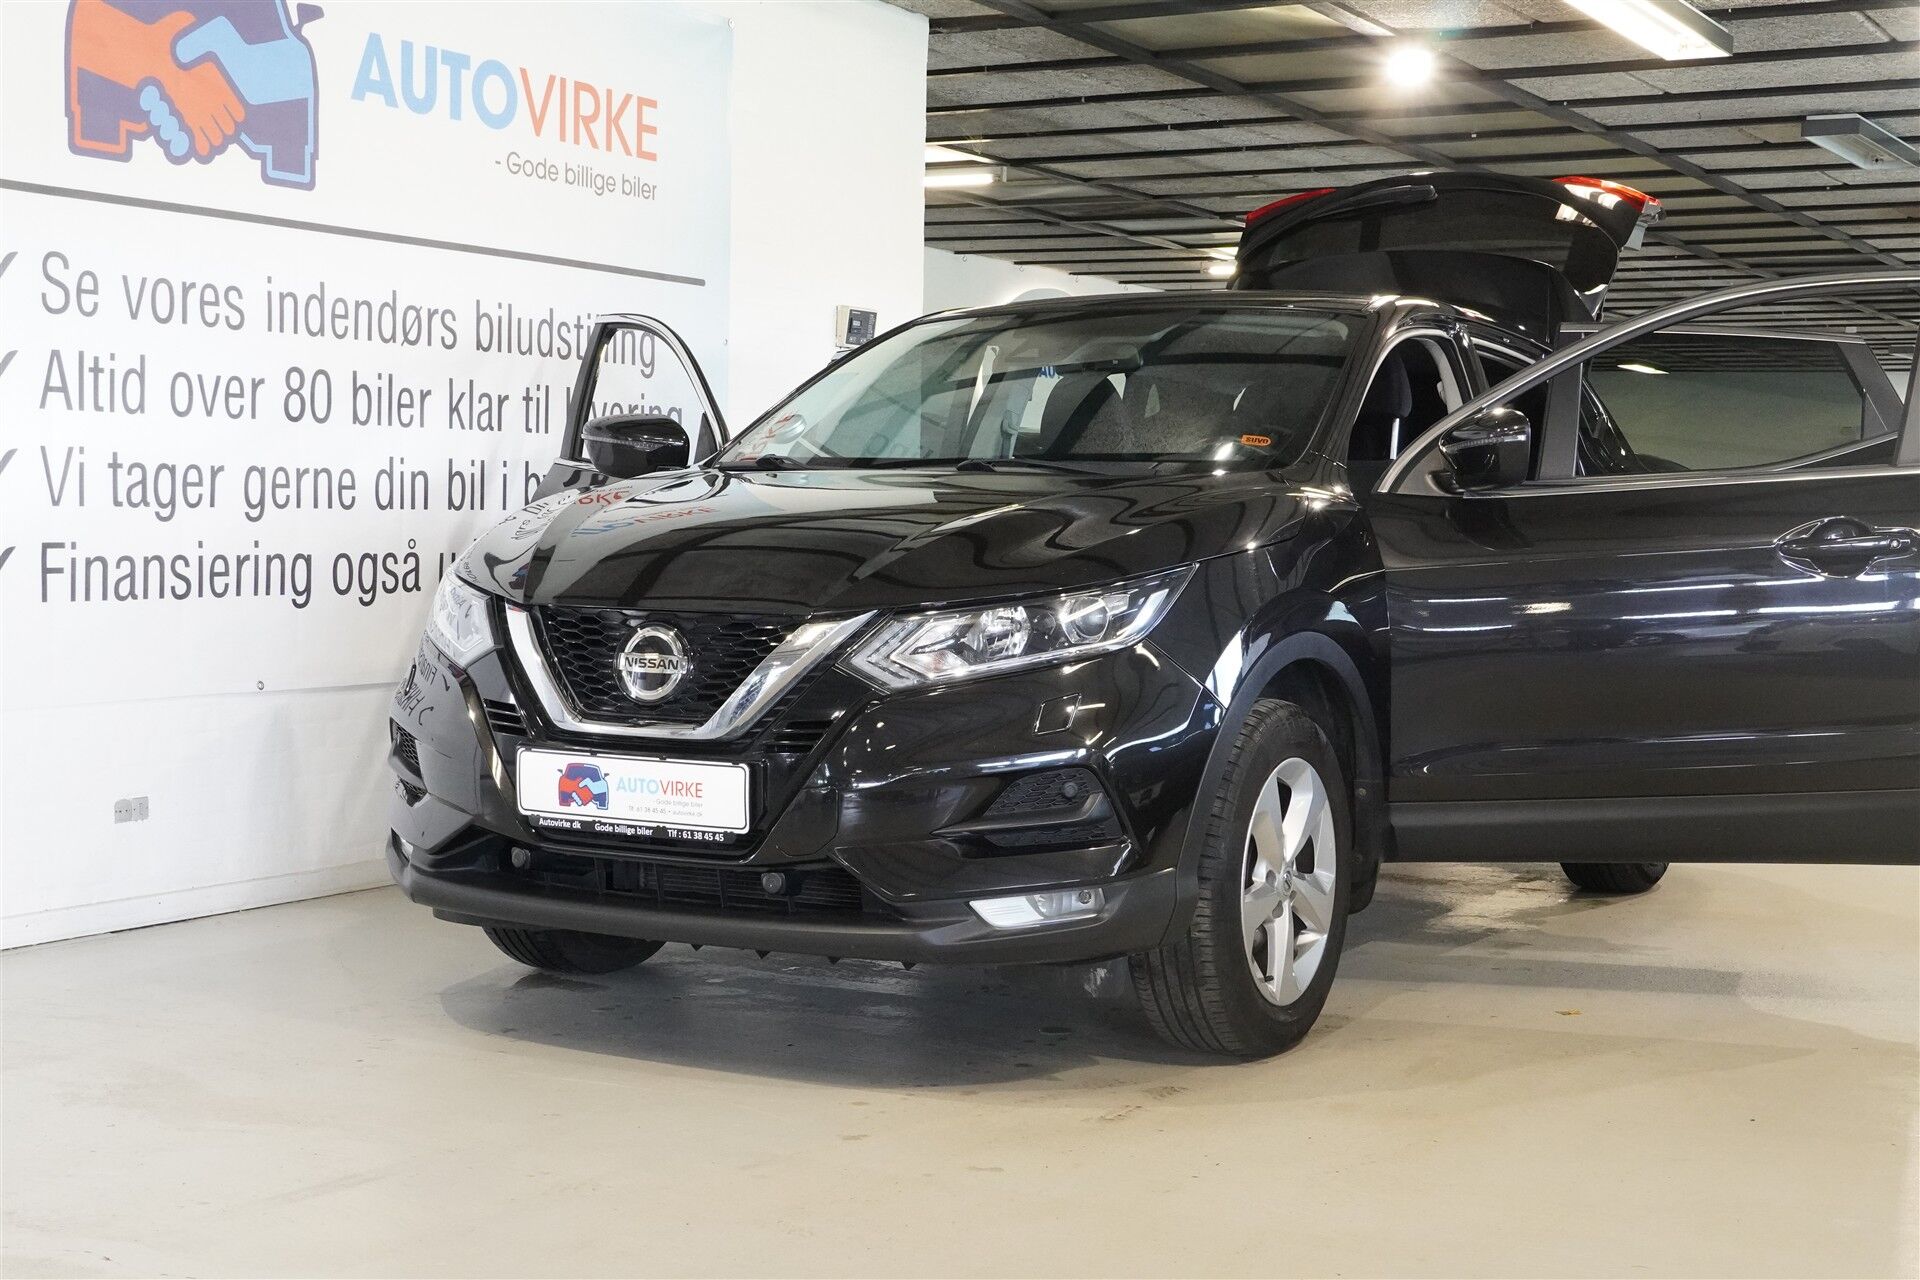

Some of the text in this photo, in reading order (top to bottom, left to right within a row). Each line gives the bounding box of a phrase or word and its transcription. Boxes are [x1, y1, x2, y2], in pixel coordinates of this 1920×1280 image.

[350, 31, 658, 163] AUTOVIRKE
[506, 151, 559, 182] Gode
[564, 162, 617, 196] billige
[621, 173, 658, 201] biler
[40, 250, 100, 318] Se
[122, 274, 246, 332] vores
[266, 275, 458, 351] indendørs
[38, 348, 146, 415] Altid
[169, 371, 266, 420] over
[283, 365, 333, 425] 80
[351, 368, 433, 429] biler
[448, 376, 511, 433] klar
[521, 383, 550, 435] til
[39, 444, 85, 508] Vi
[106, 451, 226, 523] tager
[243, 464, 357, 524] gerne
[374, 456, 430, 513] din
[447, 458, 485, 511] bil
[501, 459, 508, 511] i
[40, 538, 313, 611] Finansiering
[332, 537, 422, 609] også
[624, 656, 679, 671] NISSAN
[616, 777, 703, 799] AUTOVIRKE
[539, 817, 571, 828] Autovirke
[594, 823, 613, 833] Gode
[614, 824, 636, 836] billige
[636, 826, 654, 836] biler
[667, 829, 678, 838] Tlf
[682, 830, 692, 839] 61
[693, 831, 702, 840] 38
[704, 832, 713, 841] 45
[715, 833, 724, 842] 45
